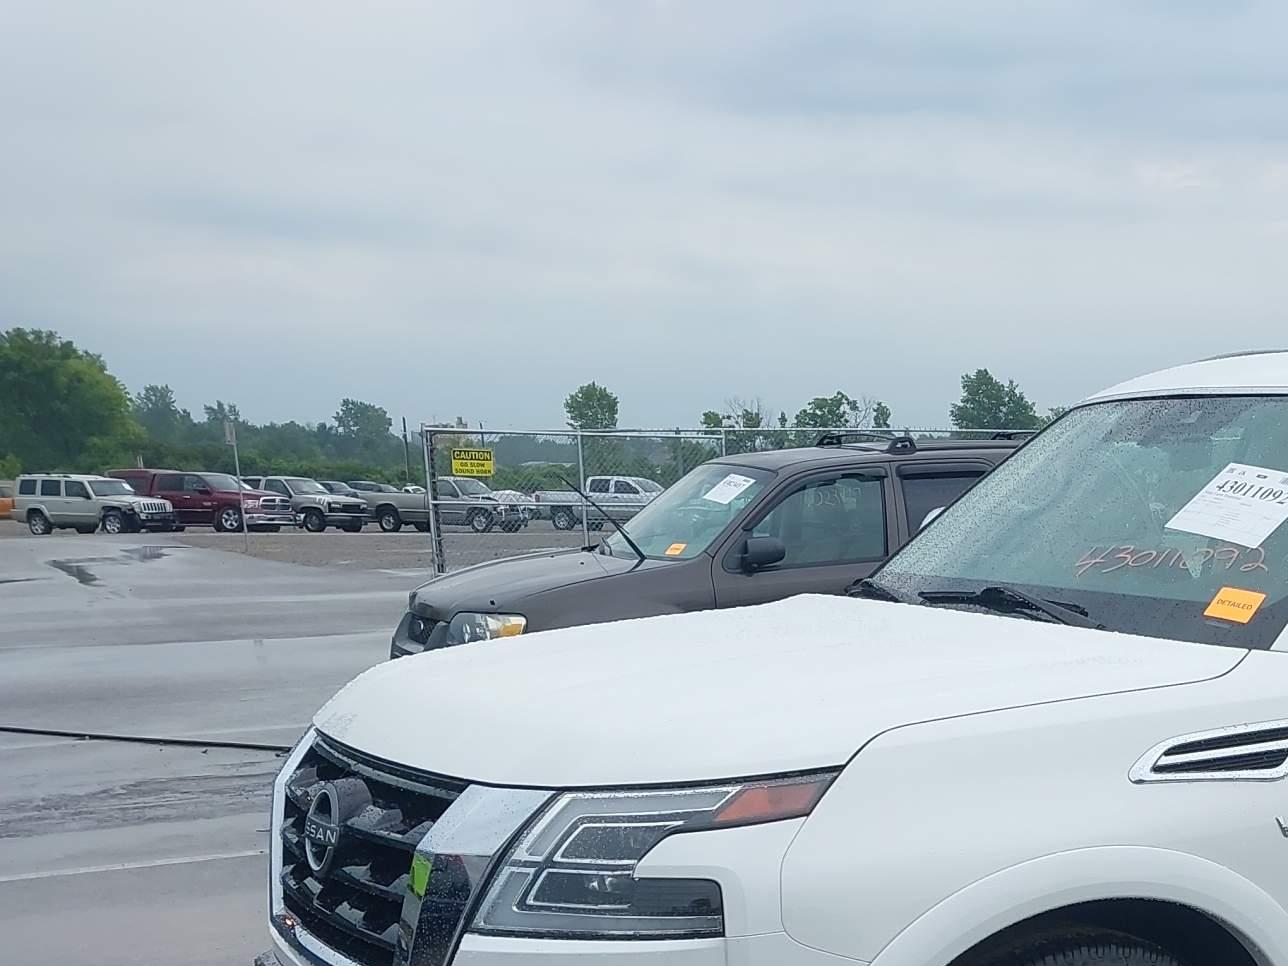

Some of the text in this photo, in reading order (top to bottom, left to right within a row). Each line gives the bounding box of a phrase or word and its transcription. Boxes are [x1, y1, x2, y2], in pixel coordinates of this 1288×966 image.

[454, 451, 491, 460] CAUTION
[1075, 545, 1269, 577] 43011092
[1215, 598, 1254, 611] DETAILED
